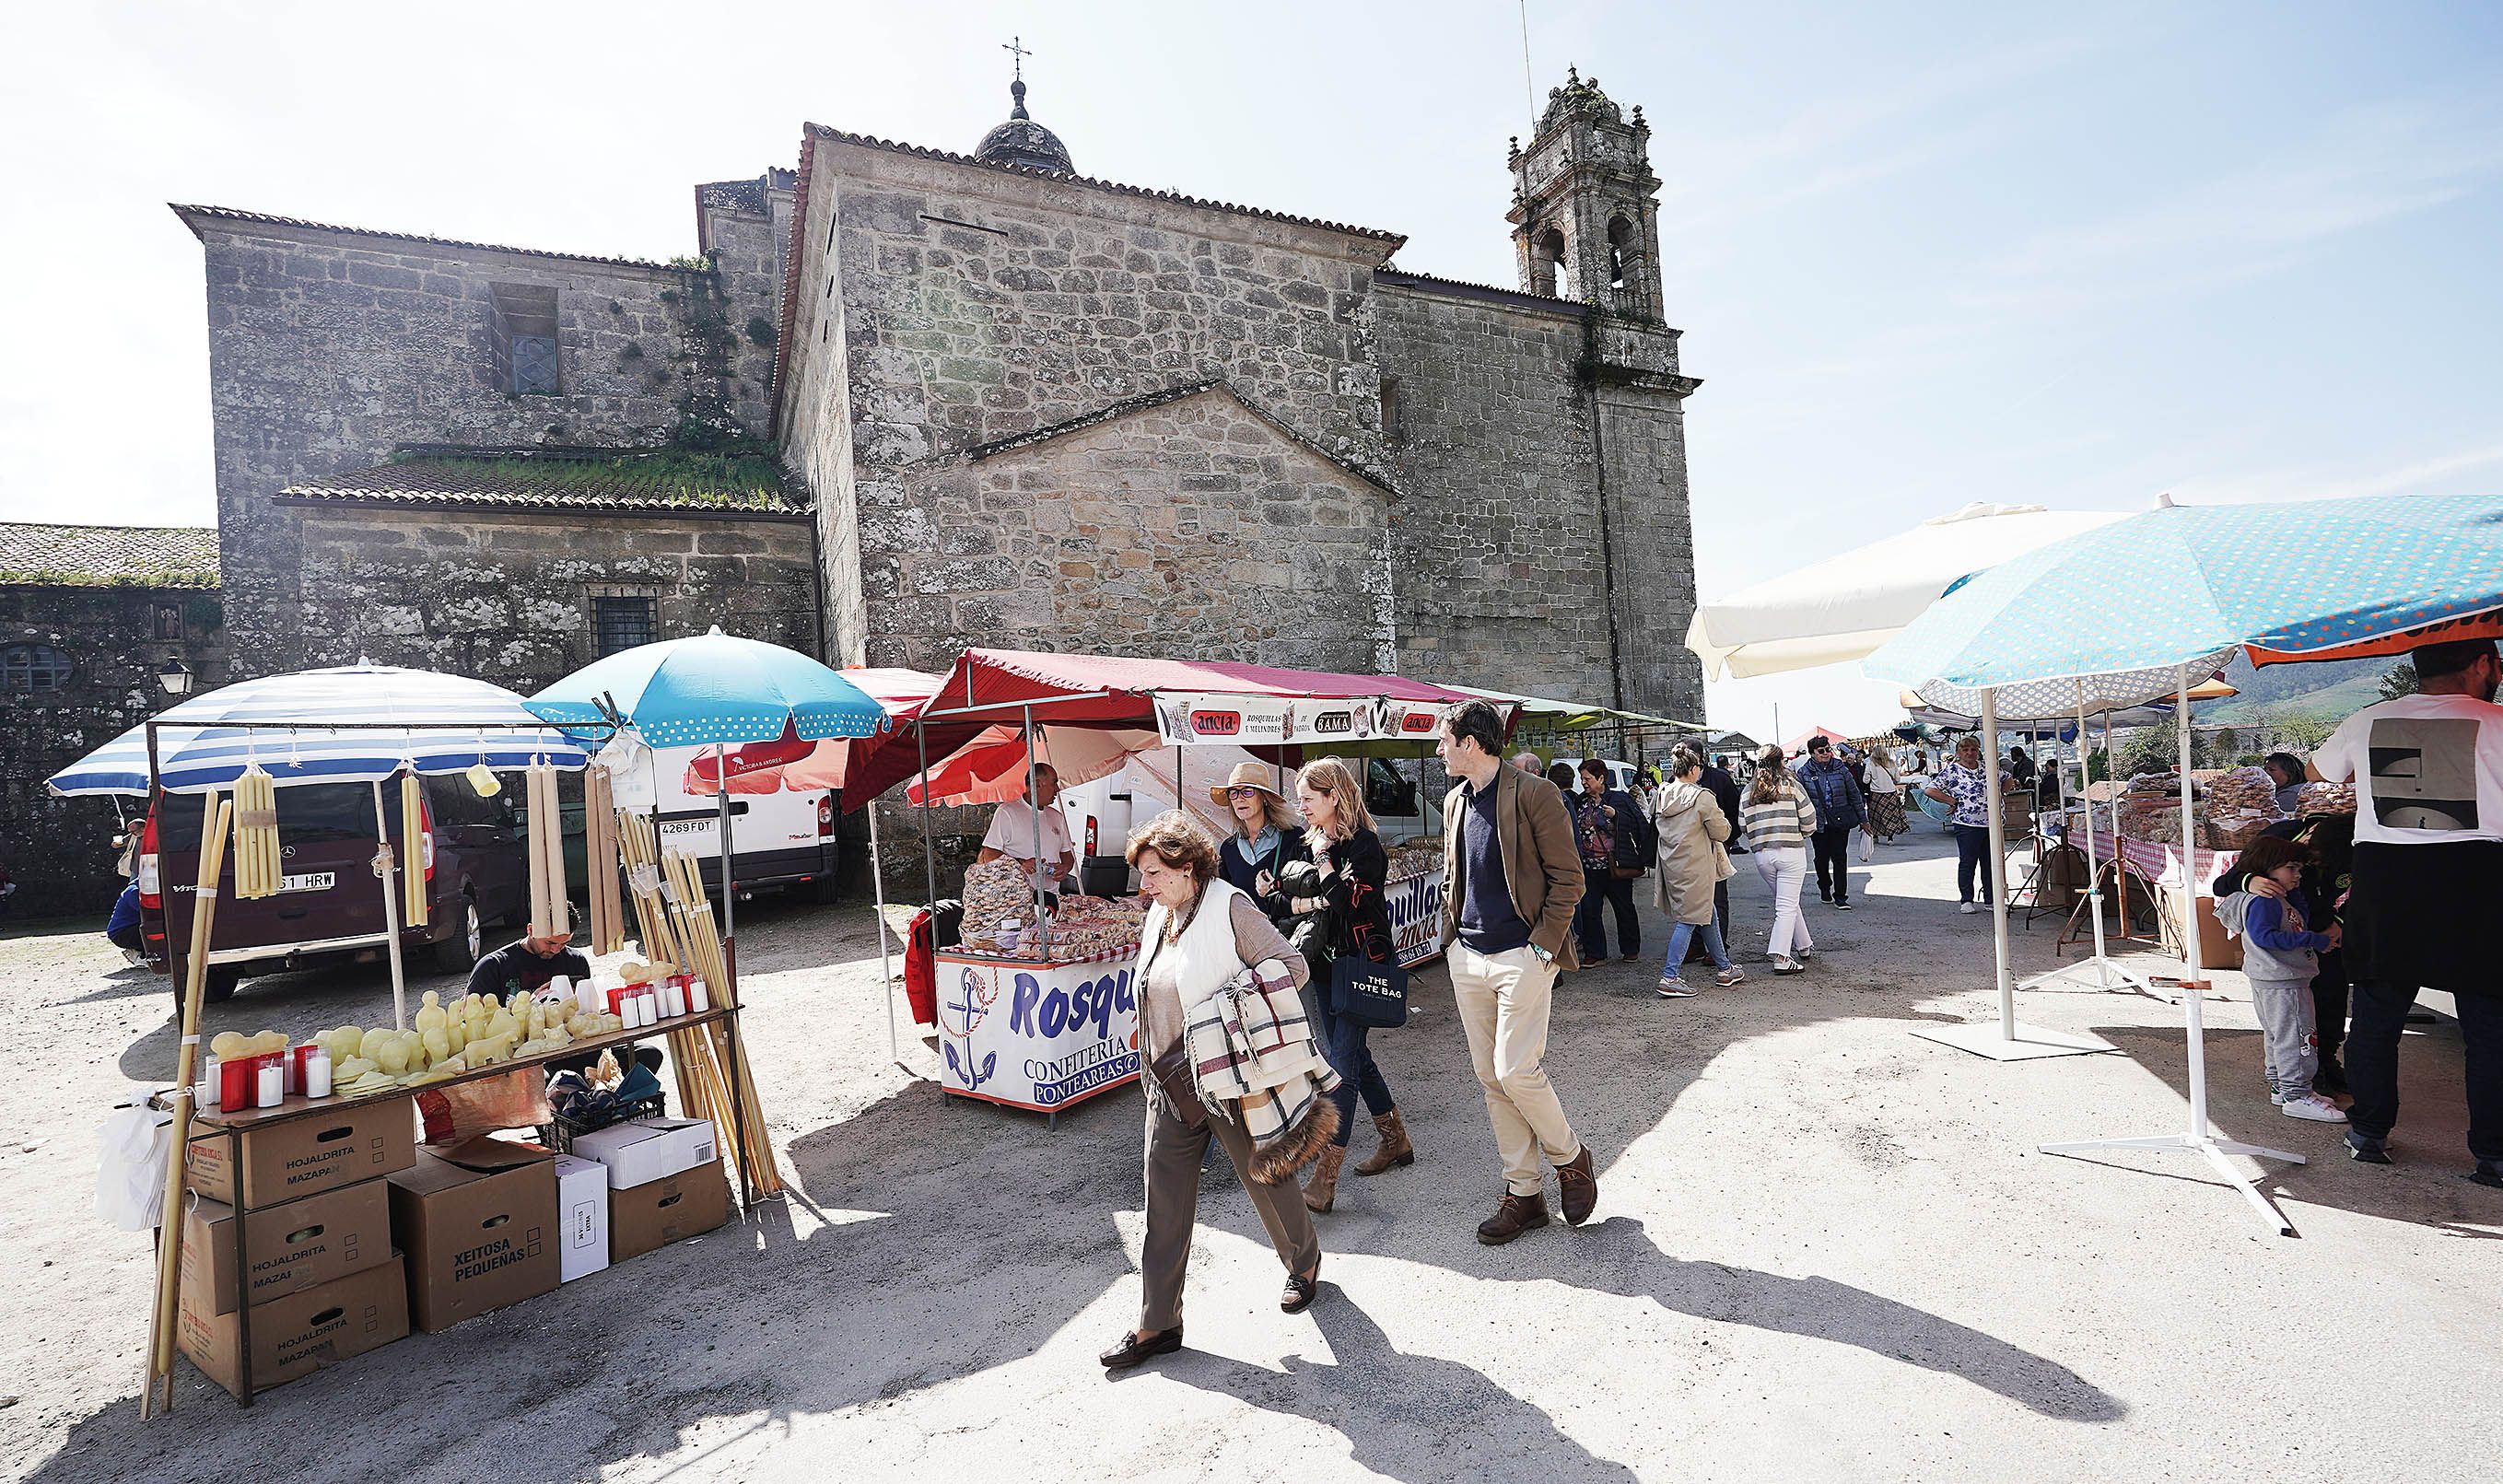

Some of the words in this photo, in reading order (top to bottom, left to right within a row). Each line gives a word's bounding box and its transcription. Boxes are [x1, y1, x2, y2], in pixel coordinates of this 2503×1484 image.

[1246, 714, 1281, 724] ROSQUILLAS
[1317, 718, 1350, 731] BAMA
[1250, 725, 1281, 733] MELINDRES
[738, 762, 759, 771] VICTORIA
[763, 758, 781, 766] ANDREA
[661, 822, 690, 834] 4269
[691, 821, 711, 833] FDT
[305, 873, 332, 887] HRW
[1408, 948, 1416, 959] 64
[1415, 945, 1422, 956] 18
[1421, 942, 1431, 954] 74
[1351, 981, 1379, 994] TOTE
[1381, 987, 1402, 999] BAG
[1368, 976, 1388, 987] THE
[1010, 967, 1136, 1039] Rosqu
[1023, 1034, 1128, 1081] CONFITERÍA
[1035, 1059, 1123, 1103] PONTEAREAS
[287, 1146, 355, 1170] HOJALDRITA
[252, 1244, 326, 1273] HOJALDRITA
[453, 1238, 510, 1267] XEITOSA
[455, 1248, 525, 1282] PEQUEÑAS
[278, 1318, 347, 1351] HOJALDRITA
